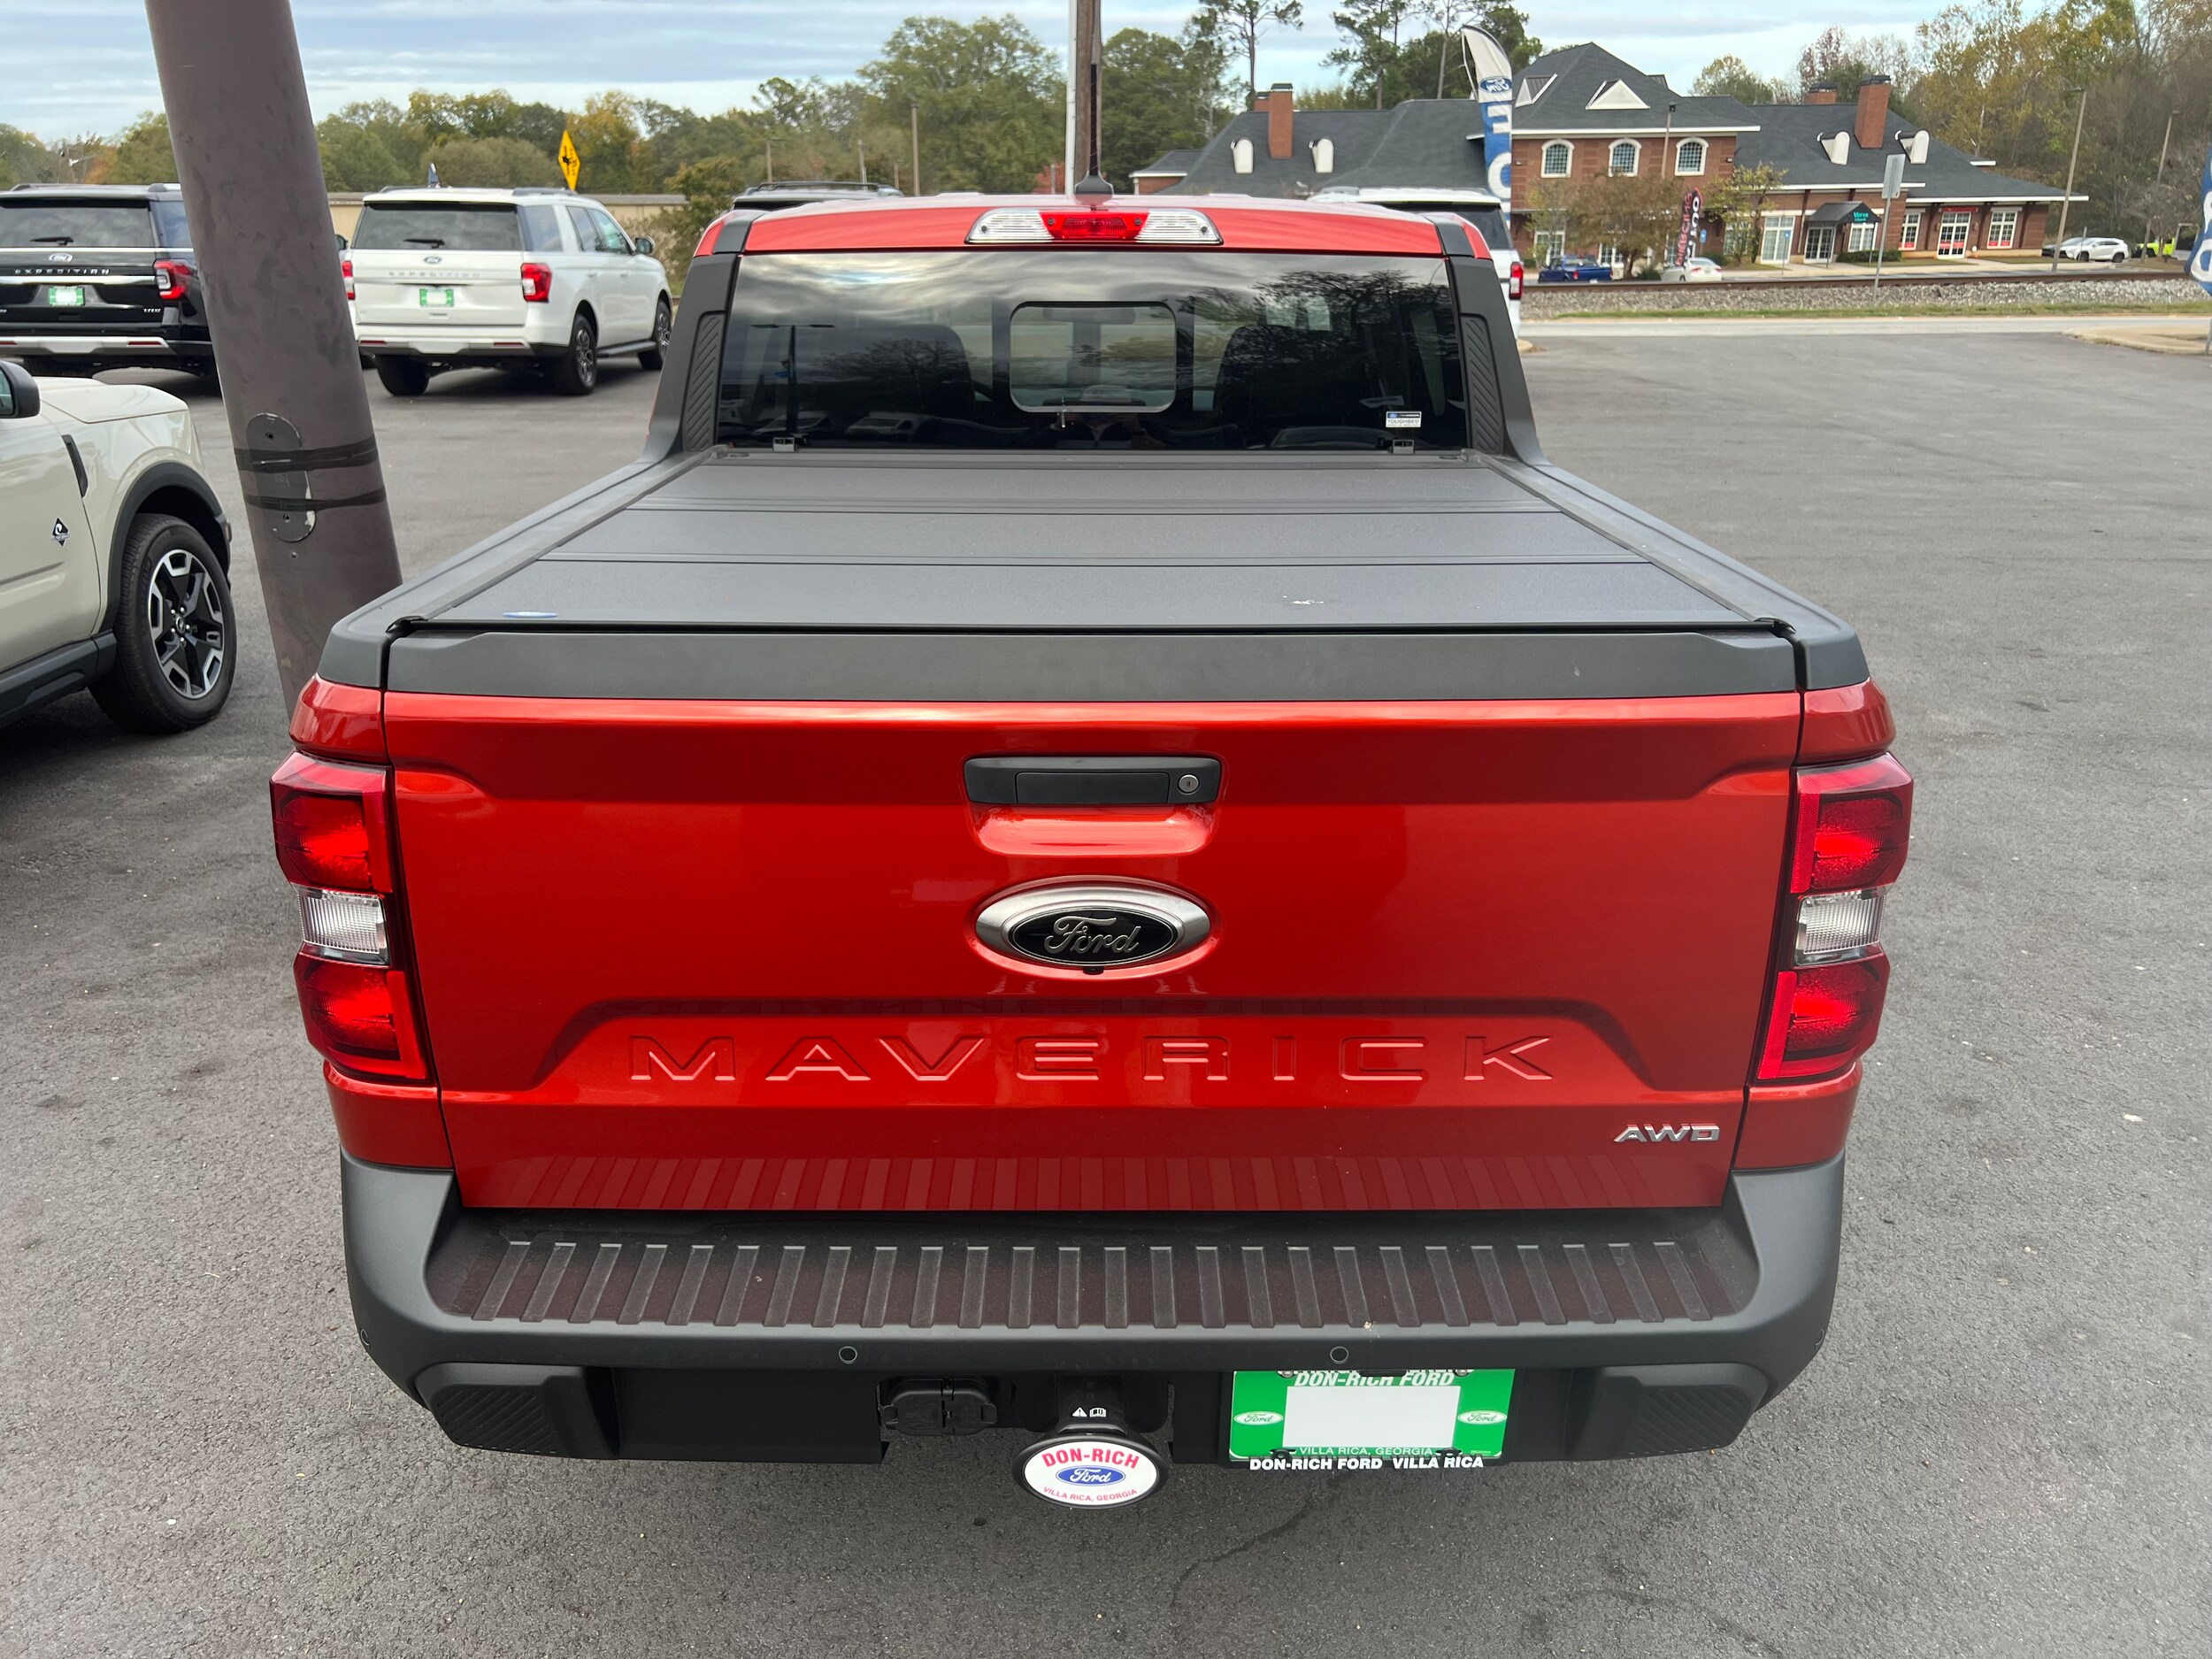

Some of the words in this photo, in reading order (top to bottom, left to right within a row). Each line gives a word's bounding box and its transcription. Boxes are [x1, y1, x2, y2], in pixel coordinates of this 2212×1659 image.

[1044, 916, 1141, 954] Ford
[629, 1035, 1553, 1081] MAVERICK
[1614, 1124, 1720, 1143] AWD
[1399, 1371, 1455, 1386] FORD
[1041, 1448, 1140, 1469] DON-RICH
[1249, 1458, 1333, 1470] DON-RICH
[1337, 1458, 1383, 1469] FORD
[1392, 1457, 1439, 1469] VILLA
[1443, 1456, 1484, 1468] RICA
[1069, 1469, 1112, 1483] Ford
[1043, 1486, 1067, 1499] VILLA
[1070, 1494, 1094, 1502] RICA,
[1096, 1488, 1138, 1502] GEORGIA
